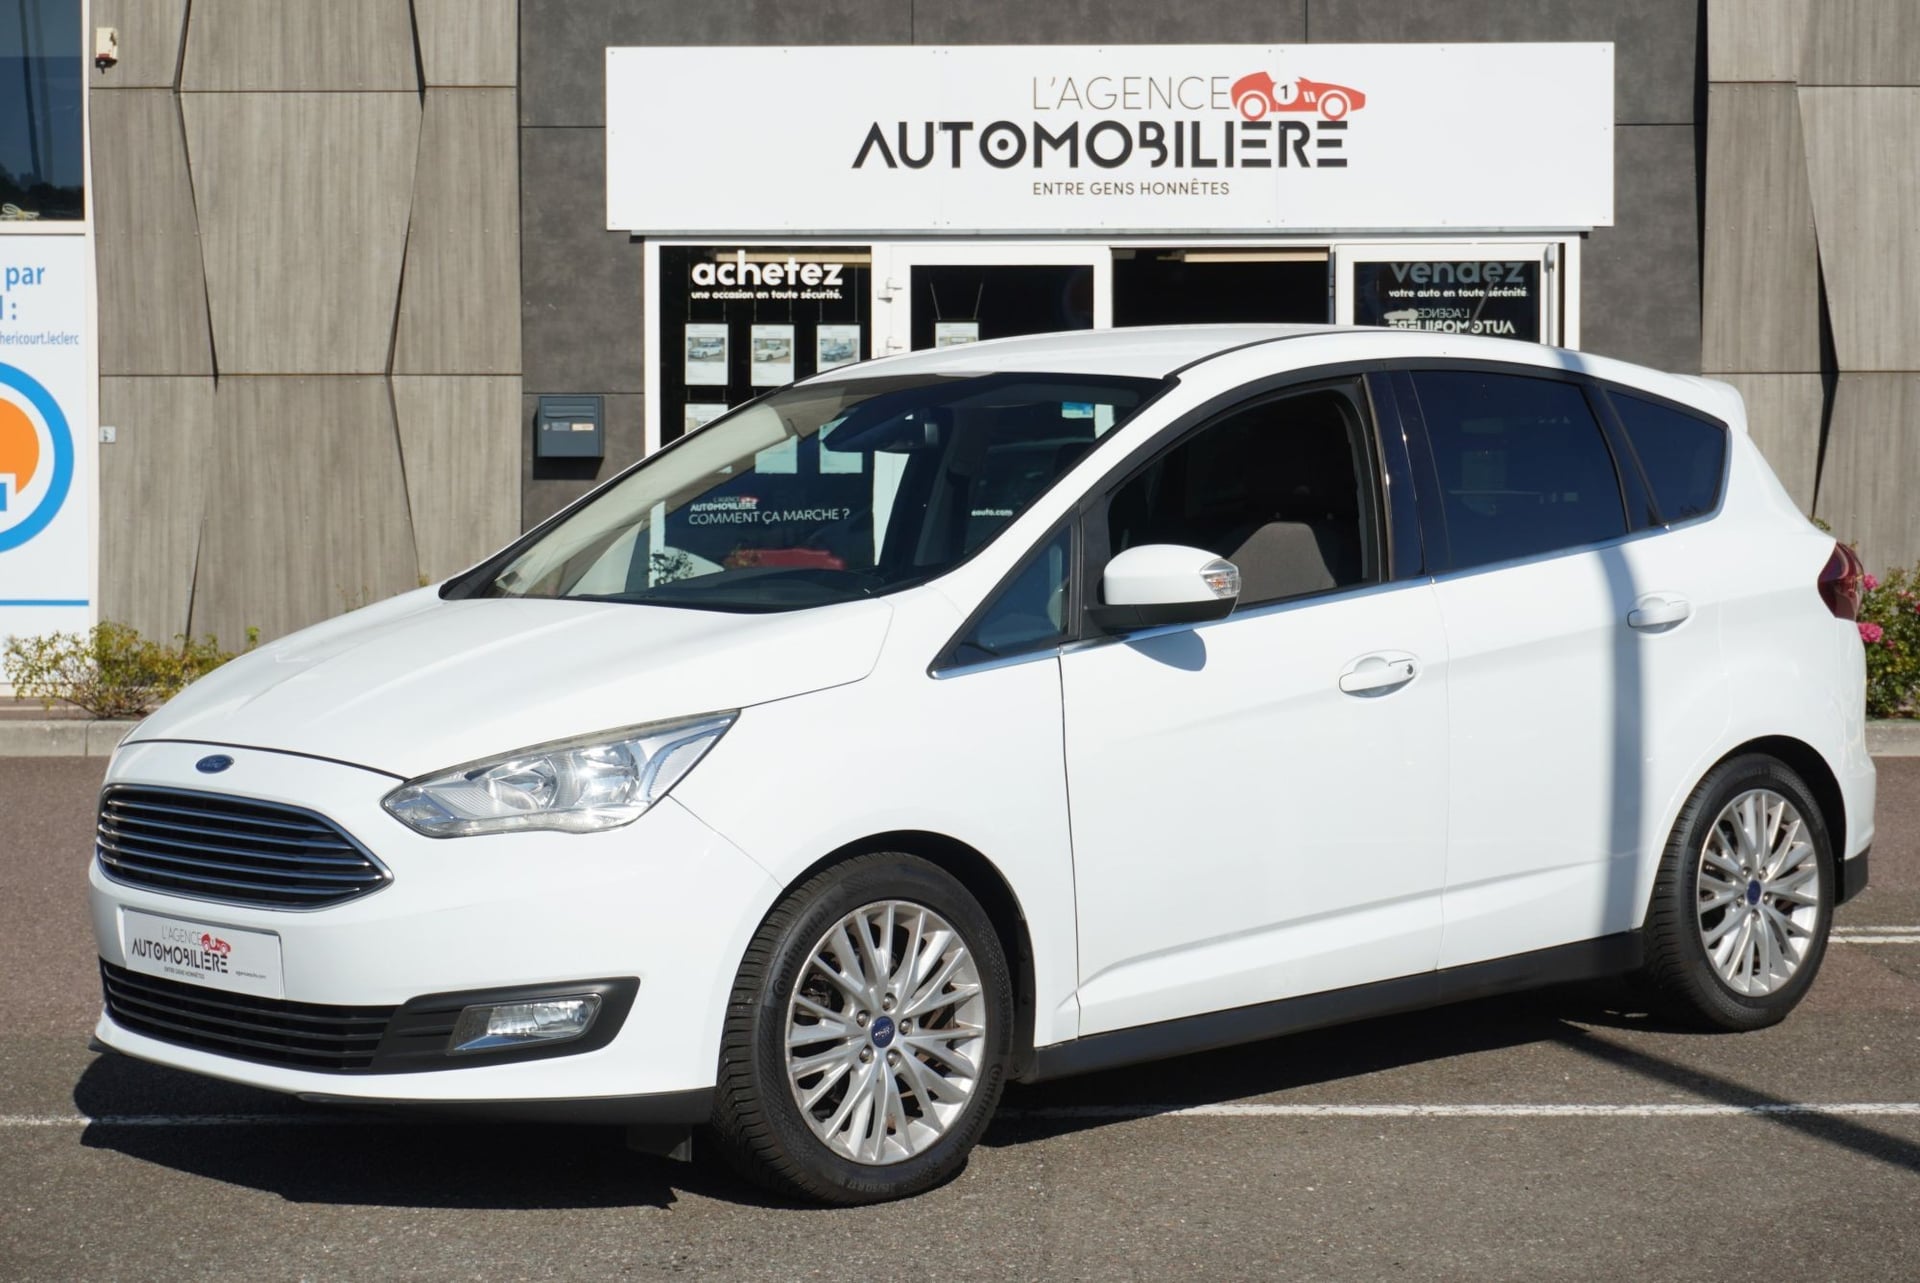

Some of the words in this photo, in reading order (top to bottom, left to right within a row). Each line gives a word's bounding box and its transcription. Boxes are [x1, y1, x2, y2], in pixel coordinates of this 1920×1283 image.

[1033, 76, 1230, 110] L'AGENCE
[1033, 182, 1084, 195] ENTRE
[1090, 182, 1134, 195] GENS
[1140, 178, 1230, 195] HONNÊTES
[691, 249, 843, 286] achetez
[1389, 262, 1525, 284] vendez
[5, 266, 46, 292] par
[691, 291, 710, 299] une
[712, 289, 754, 299] occasion
[756, 291, 769, 299] en
[771, 290, 798, 299] toute
[801, 288, 843, 299] sécurité.
[1388, 288, 1415, 298] votre
[1417, 288, 1441, 298] auto
[1443, 290, 1456, 298] en
[1458, 288, 1485, 298] toute
[688, 511, 760, 525] COMMENT
[762, 511, 781, 525] ÇA
[783, 508, 839, 522] MARCHE
[843, 508, 850, 520] ?
